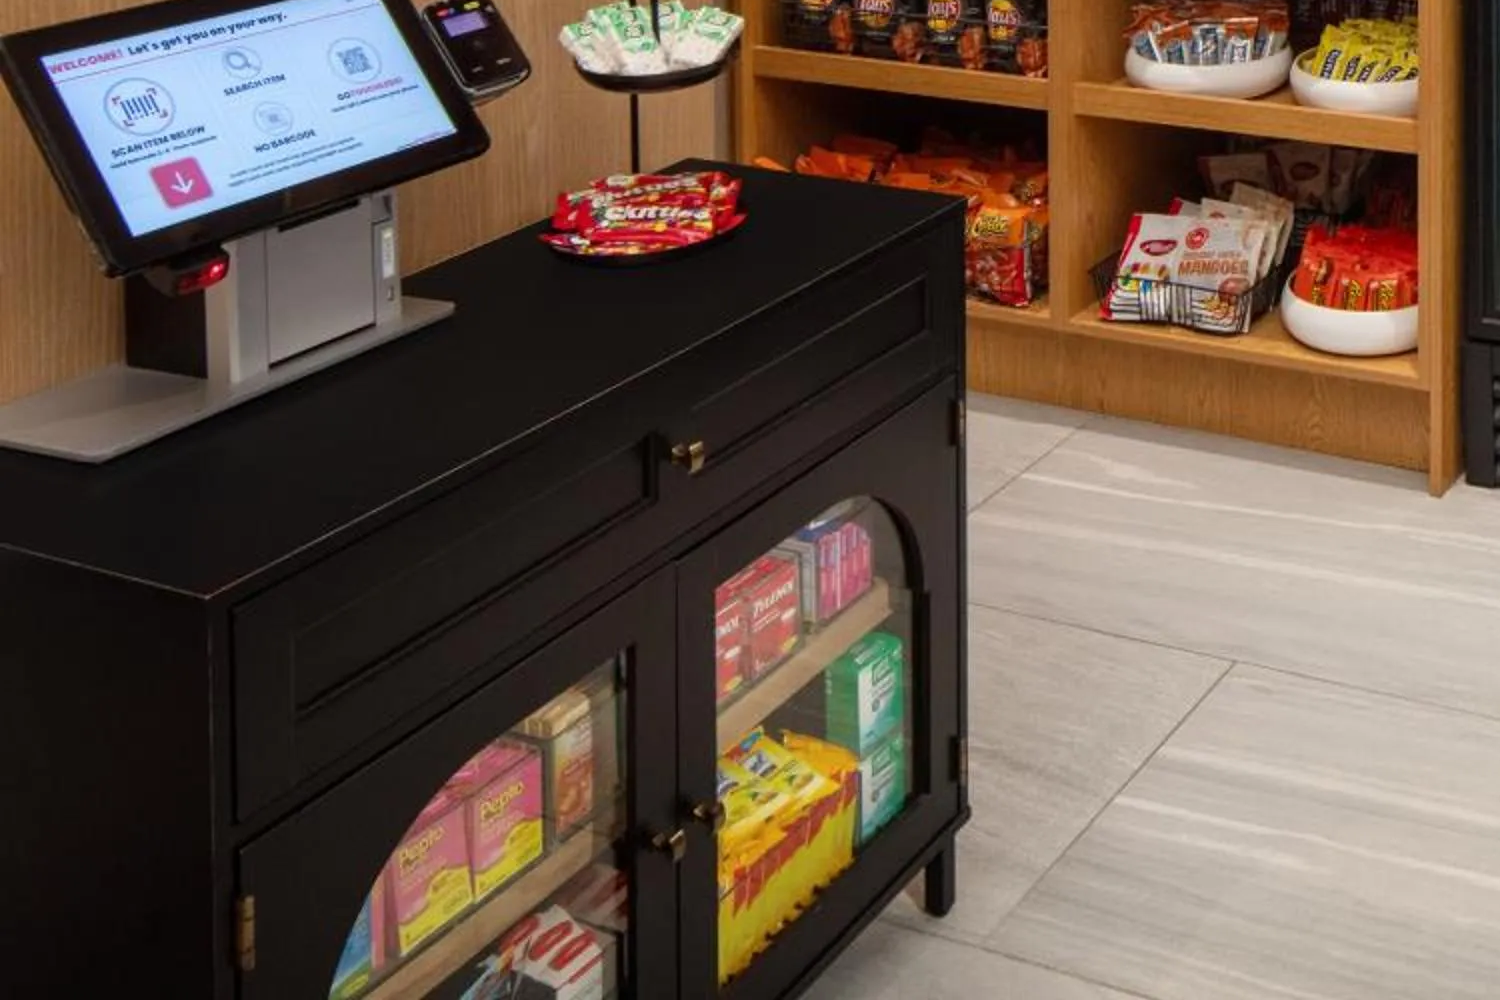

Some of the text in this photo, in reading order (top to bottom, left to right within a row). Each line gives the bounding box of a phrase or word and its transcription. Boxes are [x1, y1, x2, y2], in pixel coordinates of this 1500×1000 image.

[928, 1, 959, 17] Lay's
[46, 11, 288, 74] WELCOME! Let's get you on your way.
[223, 80, 262, 96] SEARCH
[111, 144, 142, 159] SCAN
[142, 135, 169, 149] ITEM
[169, 125, 206, 141] BELOW
[254, 128, 317, 153] NO BARCODE
[1178, 258, 1248, 278] MANGOES
